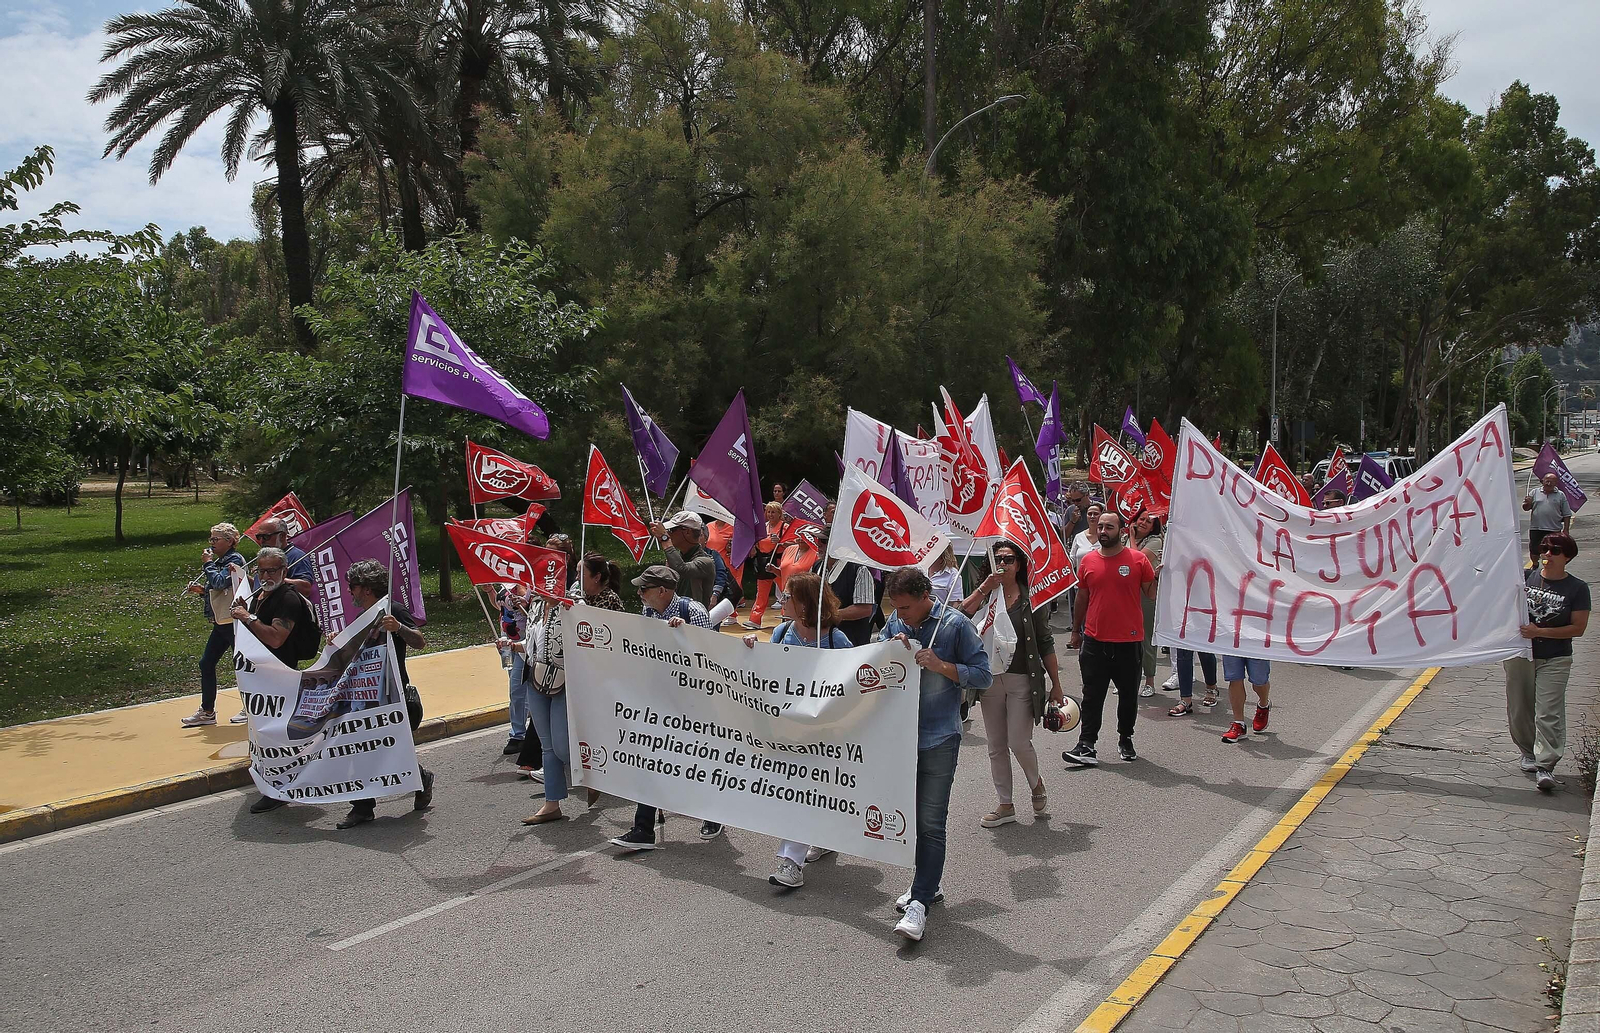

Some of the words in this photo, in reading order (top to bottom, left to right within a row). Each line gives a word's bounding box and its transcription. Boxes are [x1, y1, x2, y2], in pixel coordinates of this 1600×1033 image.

[411, 353, 460, 376] servicios
[462, 372, 470, 380] a
[1100, 443, 1131, 473] UGT
[1186, 436, 1290, 523] DIOS
[800, 507, 817, 521] mujer
[1256, 518, 1297, 573] LA
[1306, 478, 1488, 584] JUNTA
[318, 546, 344, 617] CCOO
[474, 545, 526, 580] UGT
[1179, 556, 1459, 657] AHOGA
[622, 638, 691, 668] Residencia
[693, 652, 738, 683] Tiempo
[739, 669, 780, 694] Libre
[784, 677, 806, 697] La
[809, 680, 846, 698] Línea
[670, 670, 724, 696] “Burgo
[725, 683, 793, 718] Turístico”
[326, 736, 396, 759] TIEMPO
[614, 701, 641, 721] Por
[643, 706, 659, 725] la
[662, 714, 743, 742] cobertura
[745, 731, 764, 749] de
[765, 741, 842, 759] vacantes
[845, 742, 864, 764] YA
[618, 728, 627, 745] y
[628, 733, 720, 762] ampliación
[724, 747, 746, 767] de
[750, 753, 808, 780] tiempo
[811, 767, 830, 784] en
[834, 766, 856, 788] los
[286, 779, 365, 800] VACANTES
[369, 771, 412, 788] “YA”
[612, 750, 682, 777] contratos
[685, 763, 707, 783] de
[711, 768, 748, 792] fijos
[750, 777, 861, 816] discontinuos.
[884, 813, 897, 822] ESP
